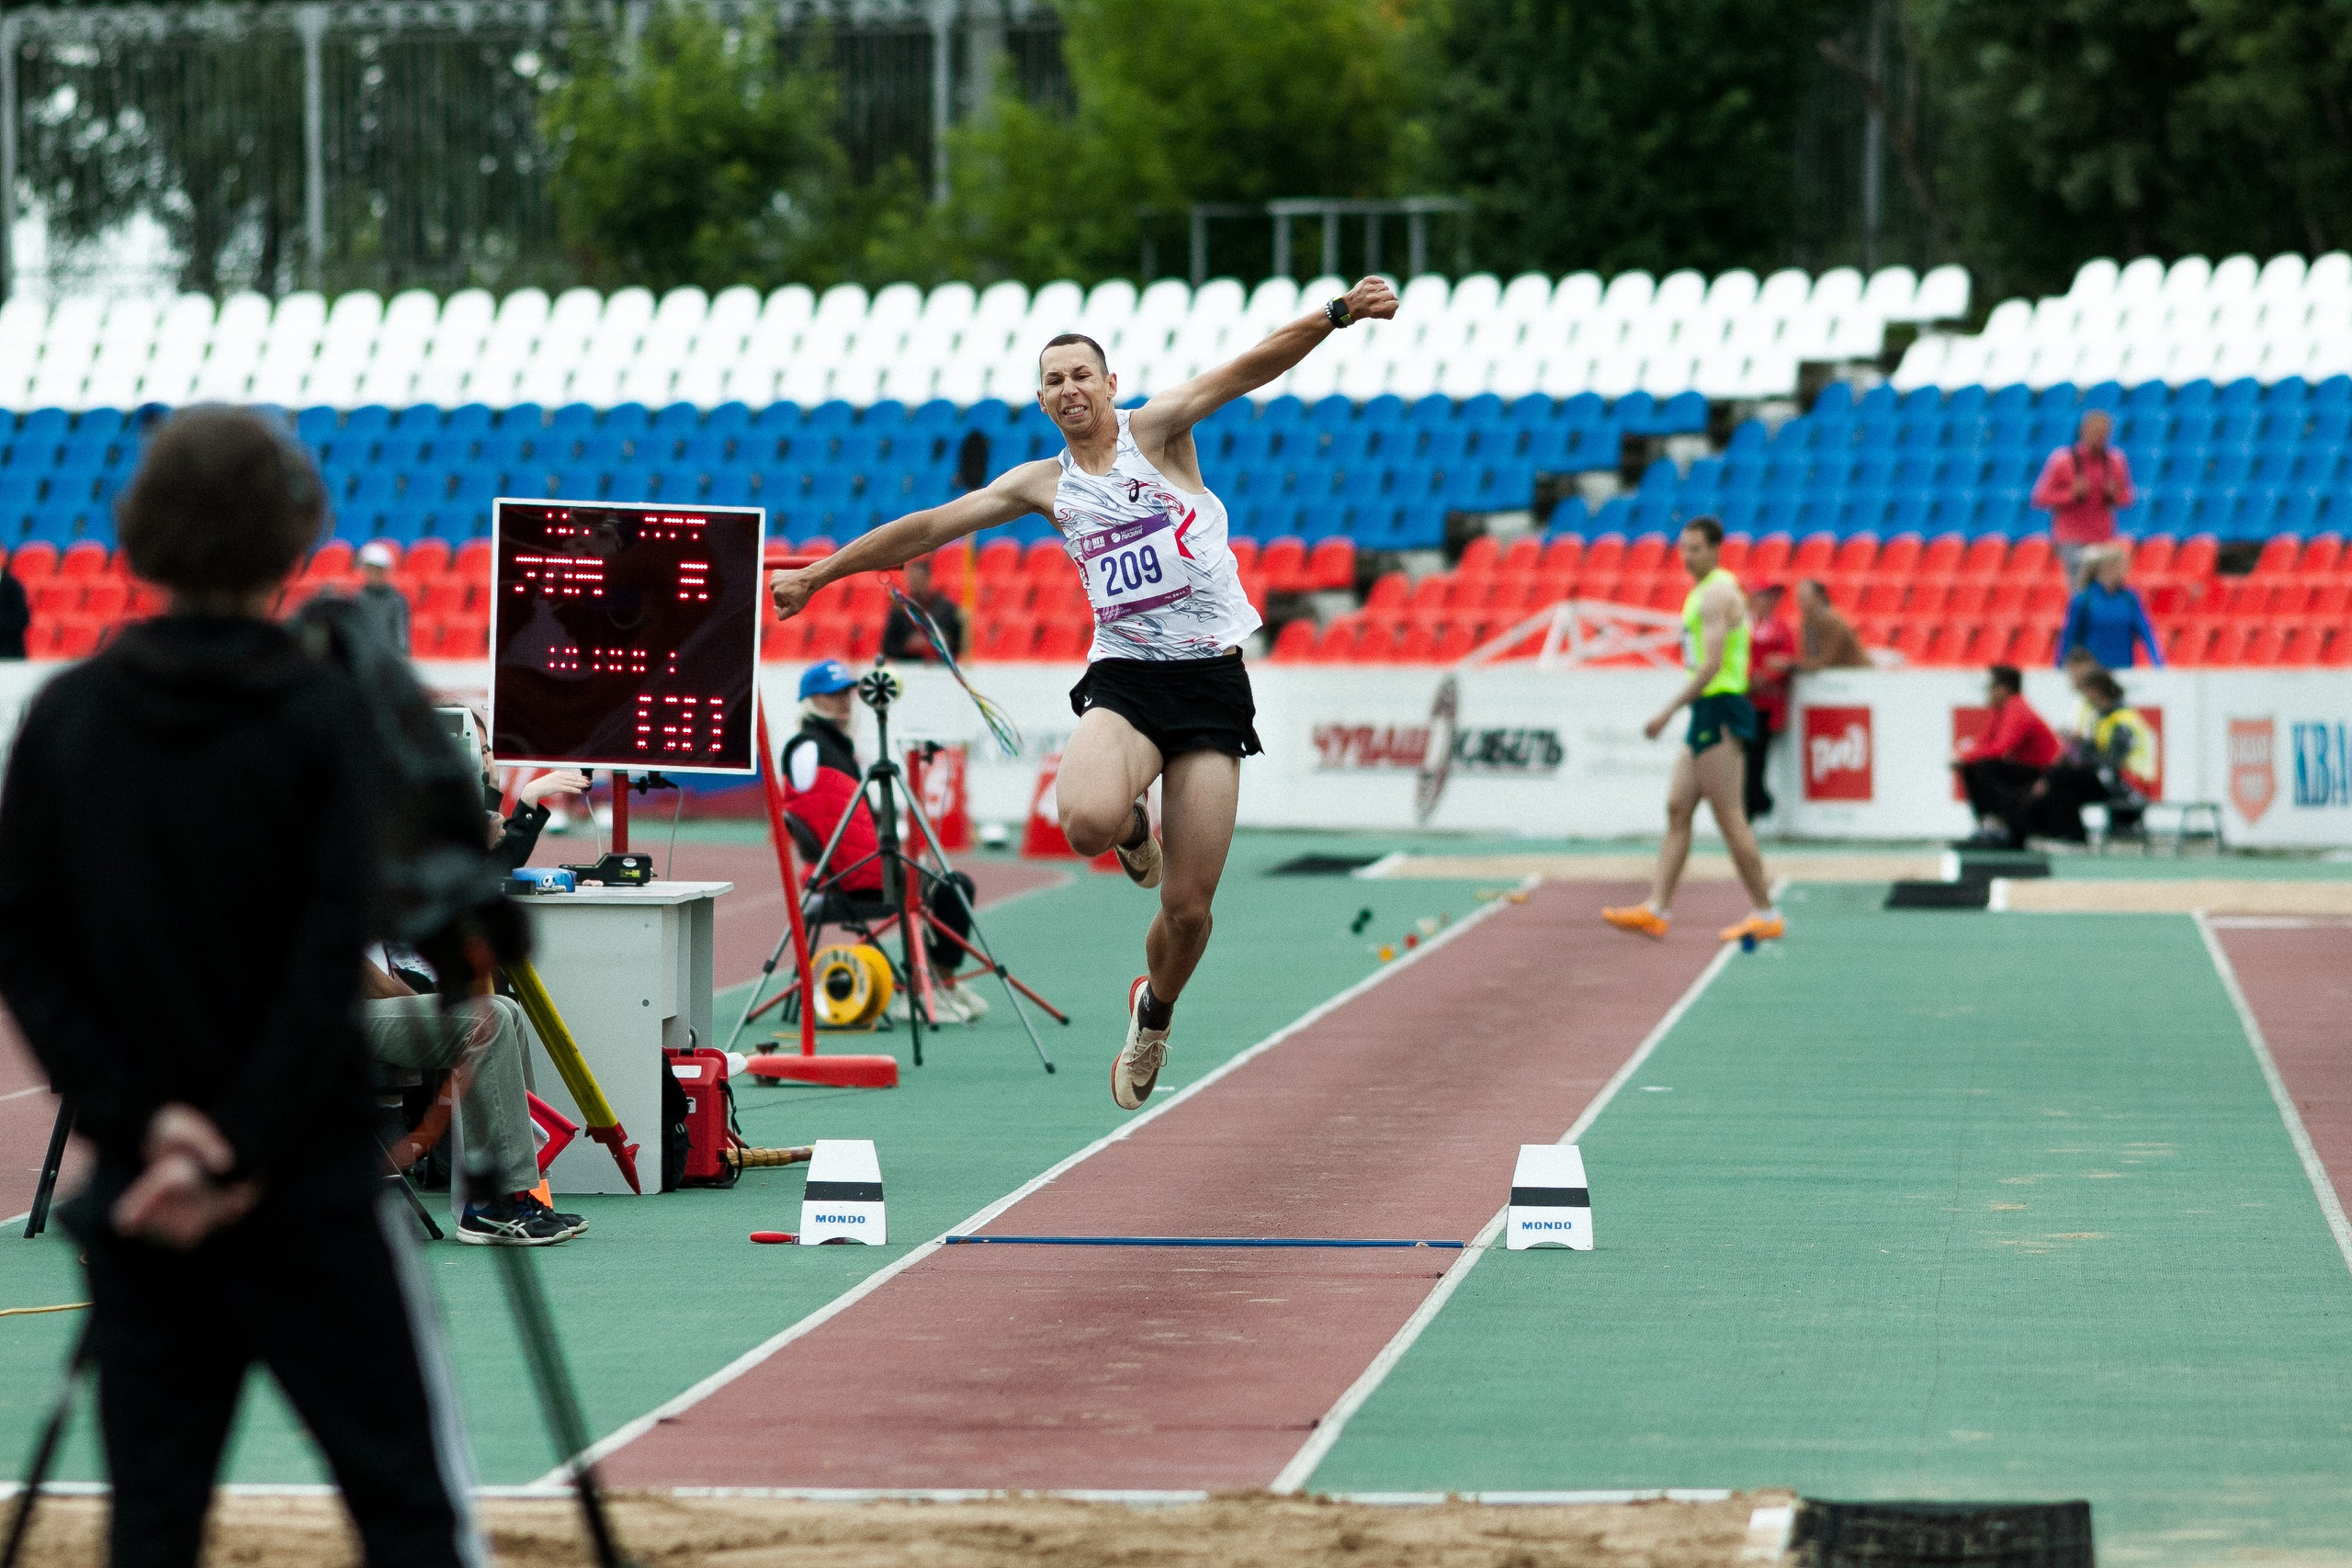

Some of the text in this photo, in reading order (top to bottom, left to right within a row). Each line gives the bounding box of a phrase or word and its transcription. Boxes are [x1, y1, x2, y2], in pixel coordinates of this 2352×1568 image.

[1100, 545, 1163, 598] 209
[815, 1214, 866, 1224] MONDO
[1521, 1221, 1572, 1230] MONDO
